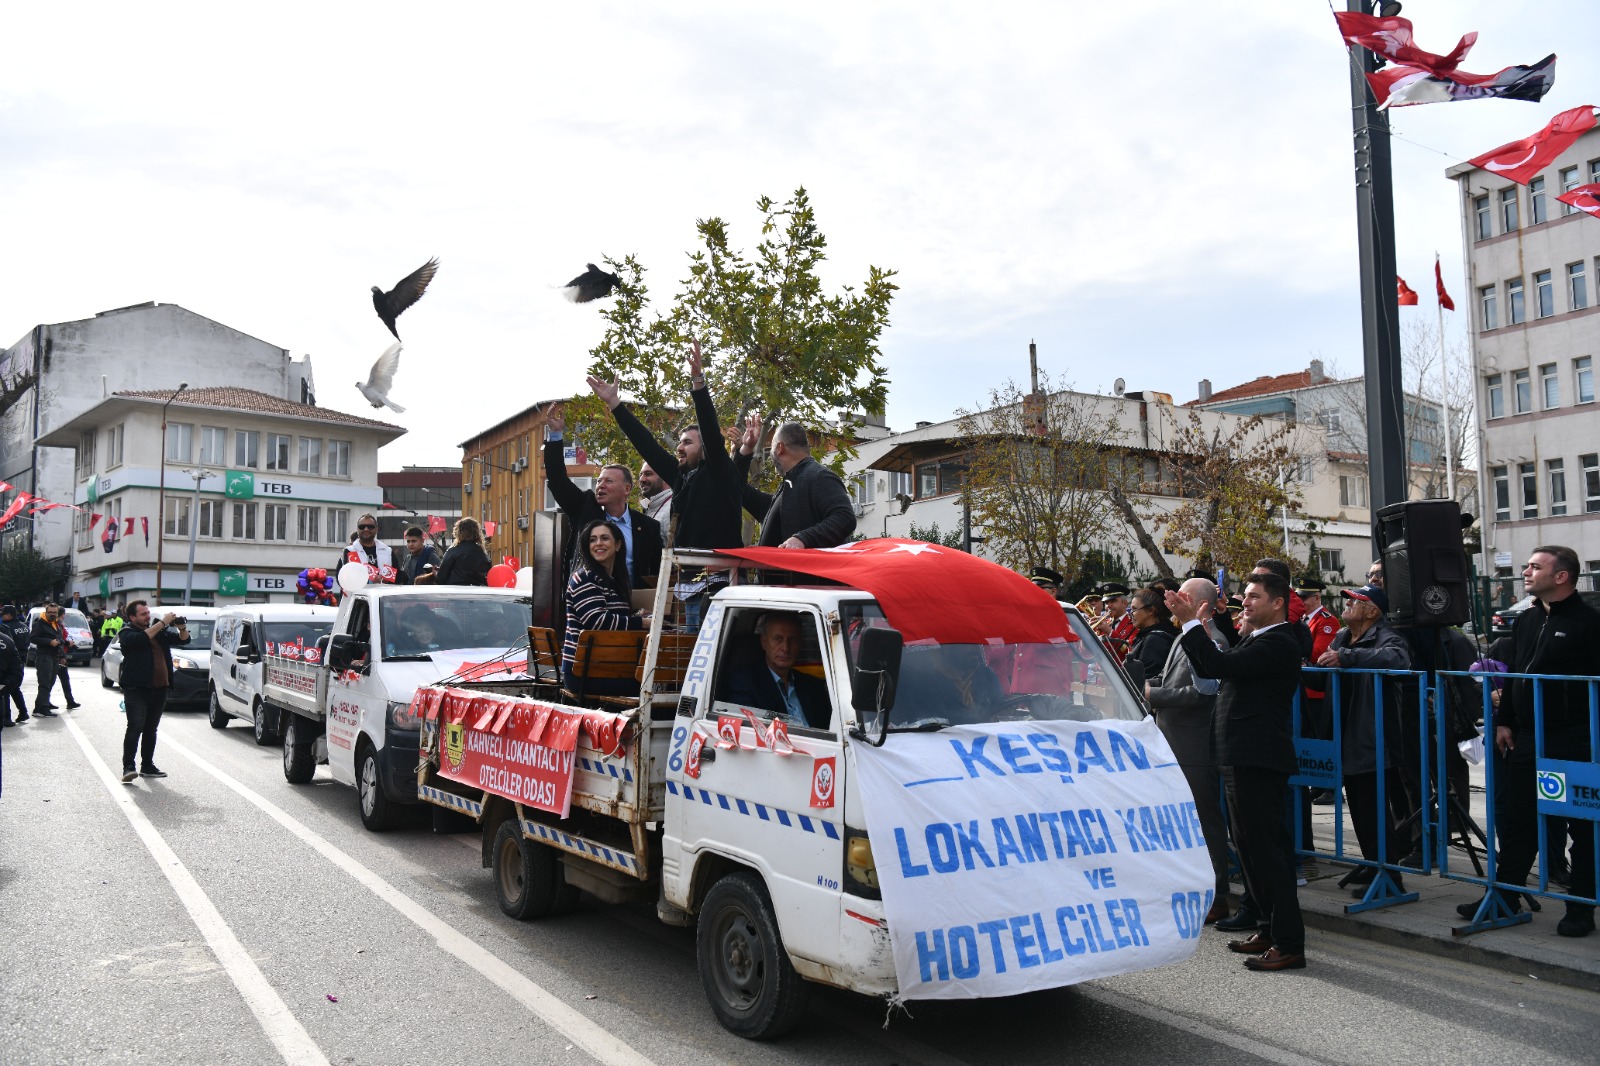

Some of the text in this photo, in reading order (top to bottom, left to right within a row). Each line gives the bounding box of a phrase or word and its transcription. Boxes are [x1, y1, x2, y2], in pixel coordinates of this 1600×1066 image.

[101, 479, 112, 492] TEB
[260, 481, 292, 495] TEB
[114, 576, 124, 588] TEB
[253, 577, 285, 589] TEB
[687, 605, 722, 696] HYUNDAI
[505, 739, 559, 772] LOKANTACI
[668, 726, 688, 772] 96
[949, 729, 1151, 784] KEŞAN
[479, 764, 556, 807] OTELCİLER ODASI
[893, 801, 1206, 879] LOKANTACI KAHVE
[1083, 867, 1117, 890] VE
